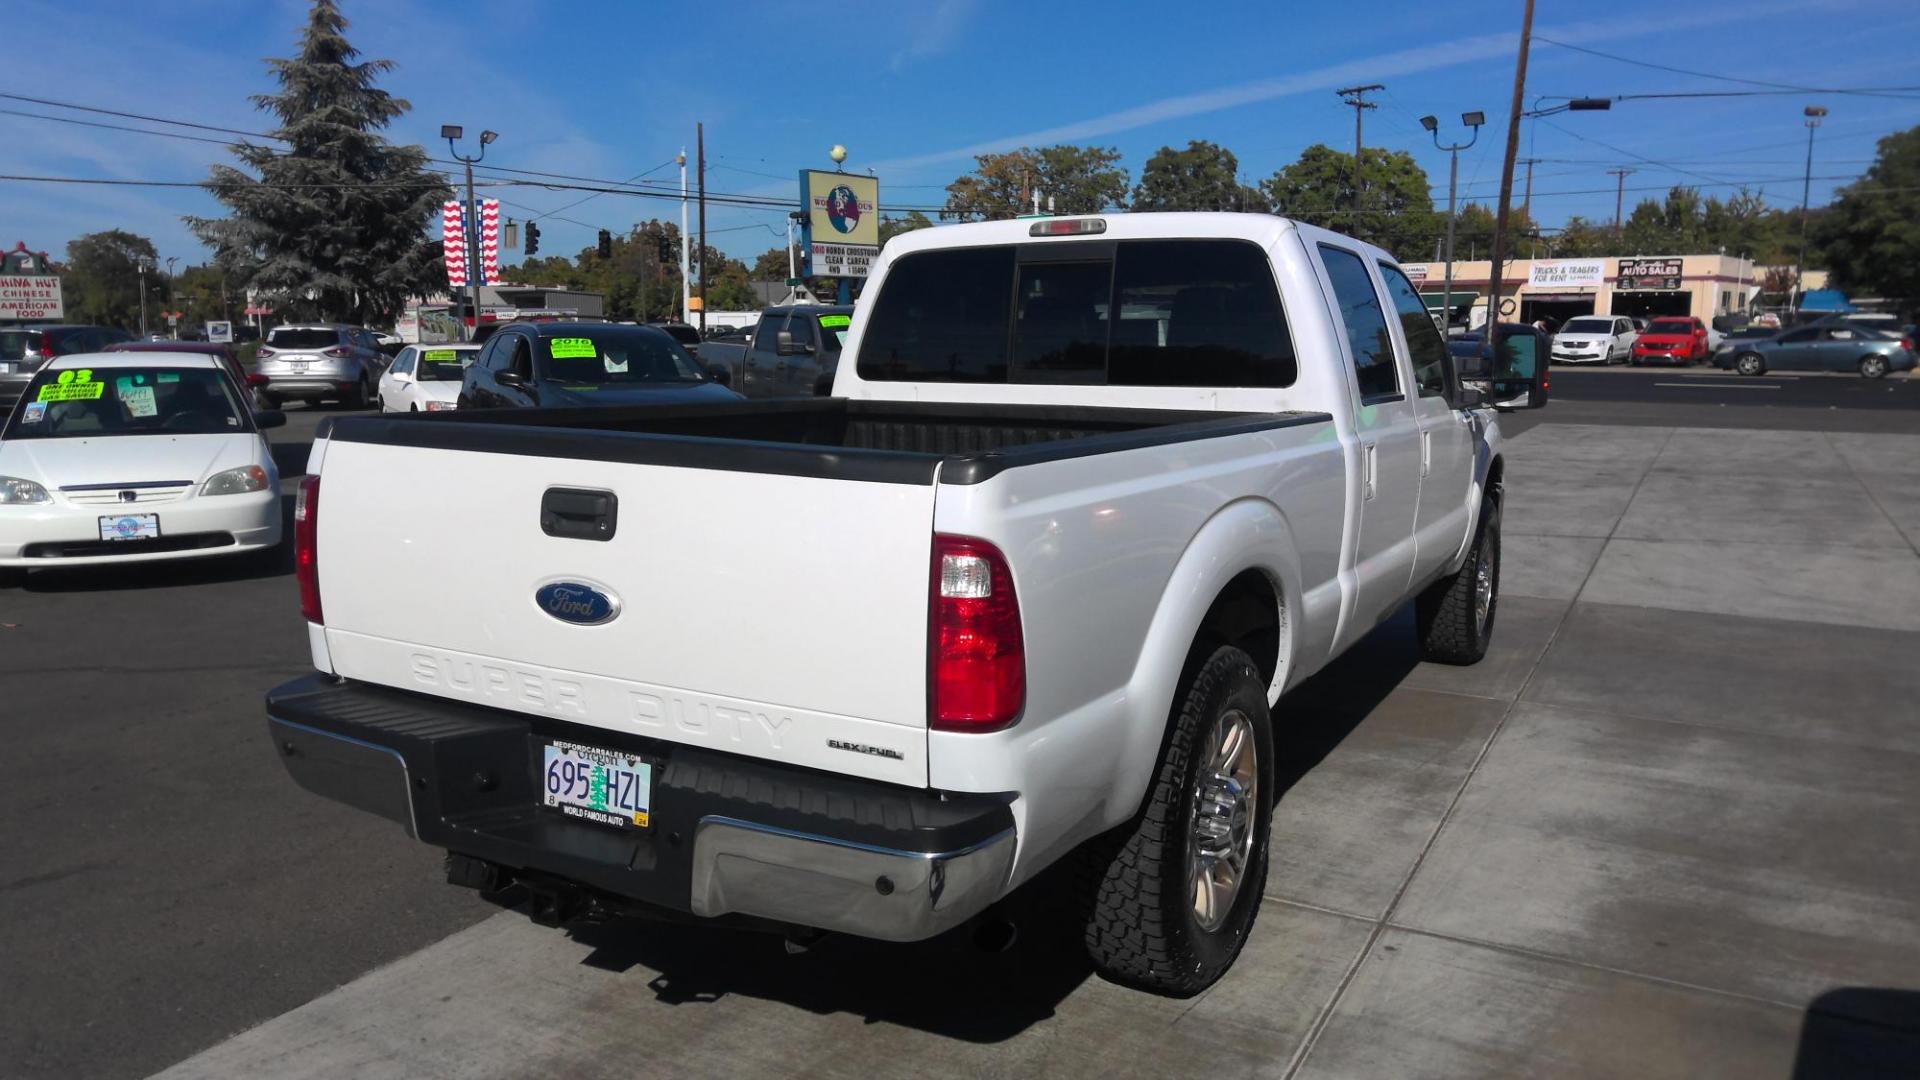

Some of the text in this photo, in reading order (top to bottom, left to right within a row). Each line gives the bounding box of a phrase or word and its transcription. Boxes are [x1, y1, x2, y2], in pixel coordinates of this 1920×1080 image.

[476, 205, 483, 221] WE
[826, 247, 845, 255] HONDA
[847, 247, 878, 256] CROSSTOUR
[825, 256, 869, 265] CLEAN CARFAX
[1534, 266, 1558, 274] TRUCKS
[1568, 265, 1600, 274] TRAILERS
[1622, 265, 1679, 276] AUTO SALES
[0, 278, 58, 288] HINA HUT
[1534, 275, 1548, 283] FOR
[1550, 274, 1568, 282] RENT
[3, 290, 51, 298] CHINESE
[1, 302, 57, 310] AMERICAN
[16, 310, 45, 318] FOOD
[550, 587, 595, 616] Ford
[410, 652, 793, 749] SUPER DUTY
[553, 740, 641, 762] MEDFORDCARSALES.COM
[828, 739, 904, 760] FLEX FUEL
[578, 751, 619, 767] Oregon
[547, 759, 648, 814] 695 HZL
[549, 795, 555, 805] 8
[563, 805, 624, 827] WORLD FAMOUS AUTO
